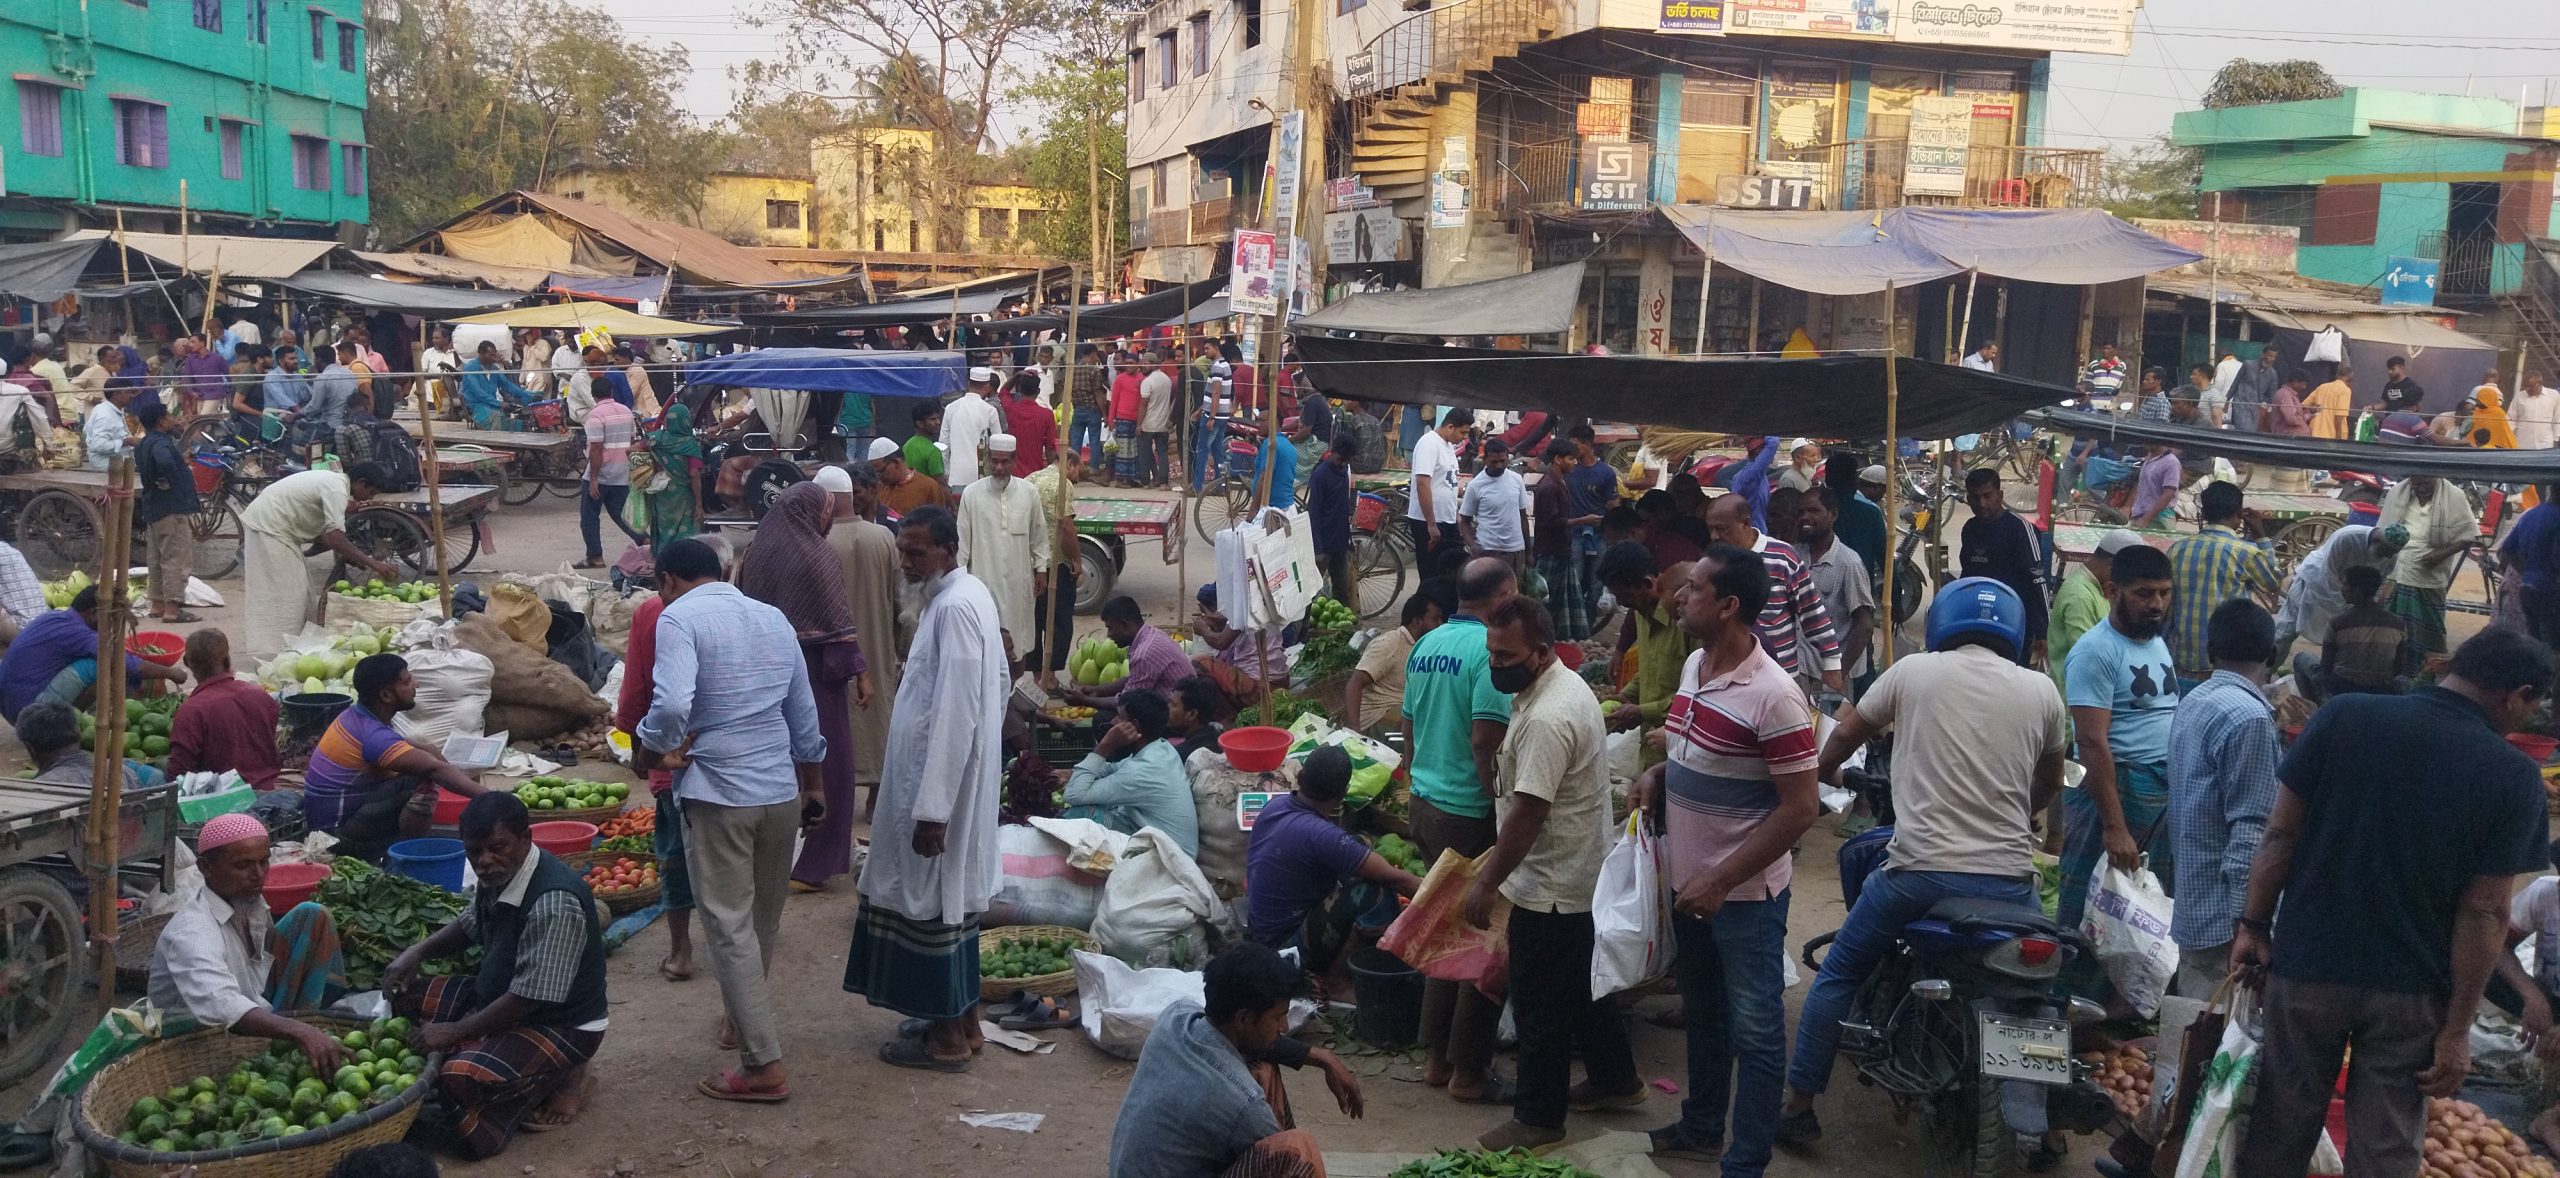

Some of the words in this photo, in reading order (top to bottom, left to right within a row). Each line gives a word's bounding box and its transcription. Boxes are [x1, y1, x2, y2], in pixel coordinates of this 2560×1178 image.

[1666, 2, 1689, 17] ভর্তি
[1690, 6, 1720, 20] চলছে
[1912, 1, 1961, 25] বিমানের
[1962, 4, 2003, 27] টিকেট
[1349, 71, 1374, 88] ভিসা
[1910, 146, 1943, 164] ইন্ডিয়ান
[1945, 146, 1965, 165] ভিসা
[1590, 182, 1614, 199] SS
[1618, 183, 1638, 199] IT
[1583, 201, 1595, 210] Be
[1597, 201, 1643, 211] Difference
[2142, 942, 2162, 974] FEED
